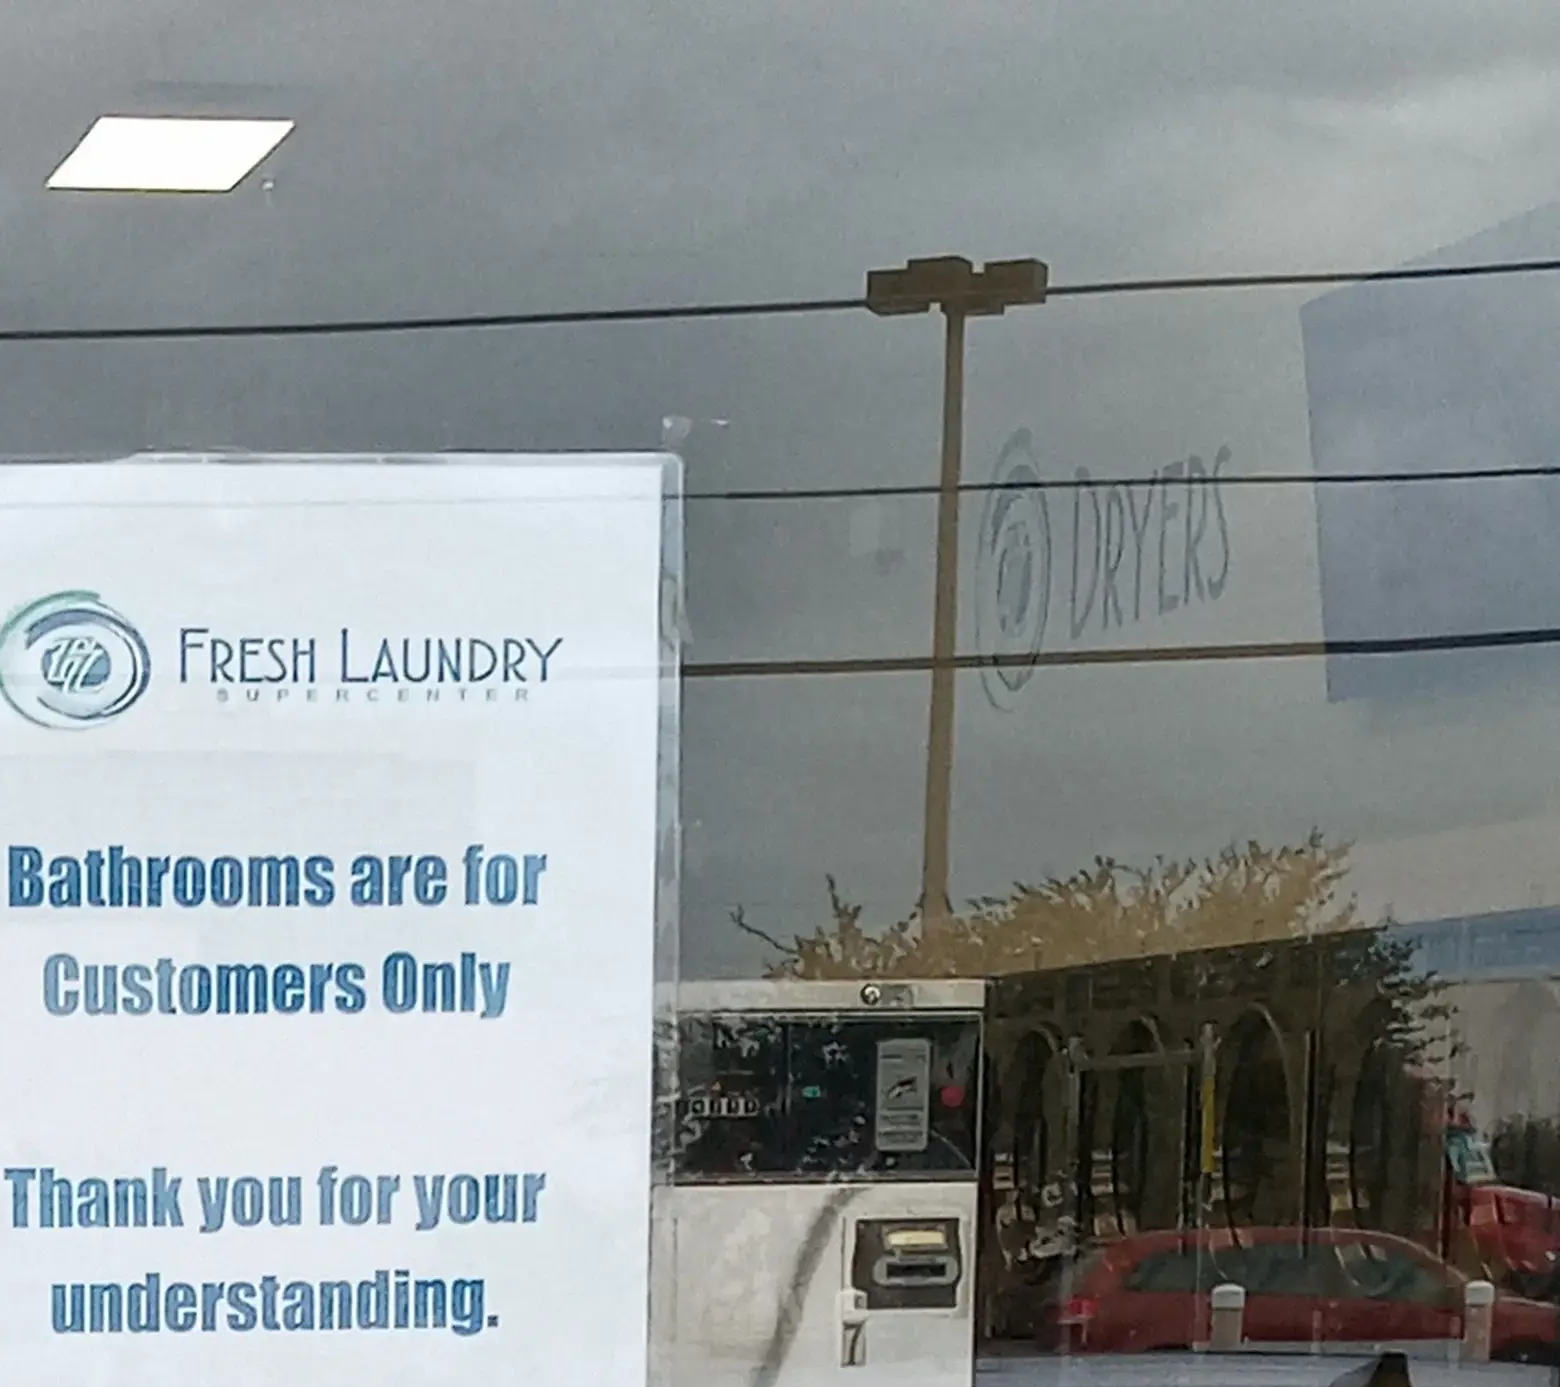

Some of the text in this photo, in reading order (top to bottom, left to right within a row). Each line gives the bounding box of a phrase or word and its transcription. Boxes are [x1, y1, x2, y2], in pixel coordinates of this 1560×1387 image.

[1070, 445, 1229, 640] DRYERS
[181, 627, 562, 684] FRESH LAUNDRY
[217, 688, 528, 703] SUPERCENTER
[9, 844, 547, 908] Bathrooms are for
[44, 951, 510, 1018] Customers Only
[4, 1165, 546, 1233] Thank you for your
[52, 1270, 498, 1336] understanding.
